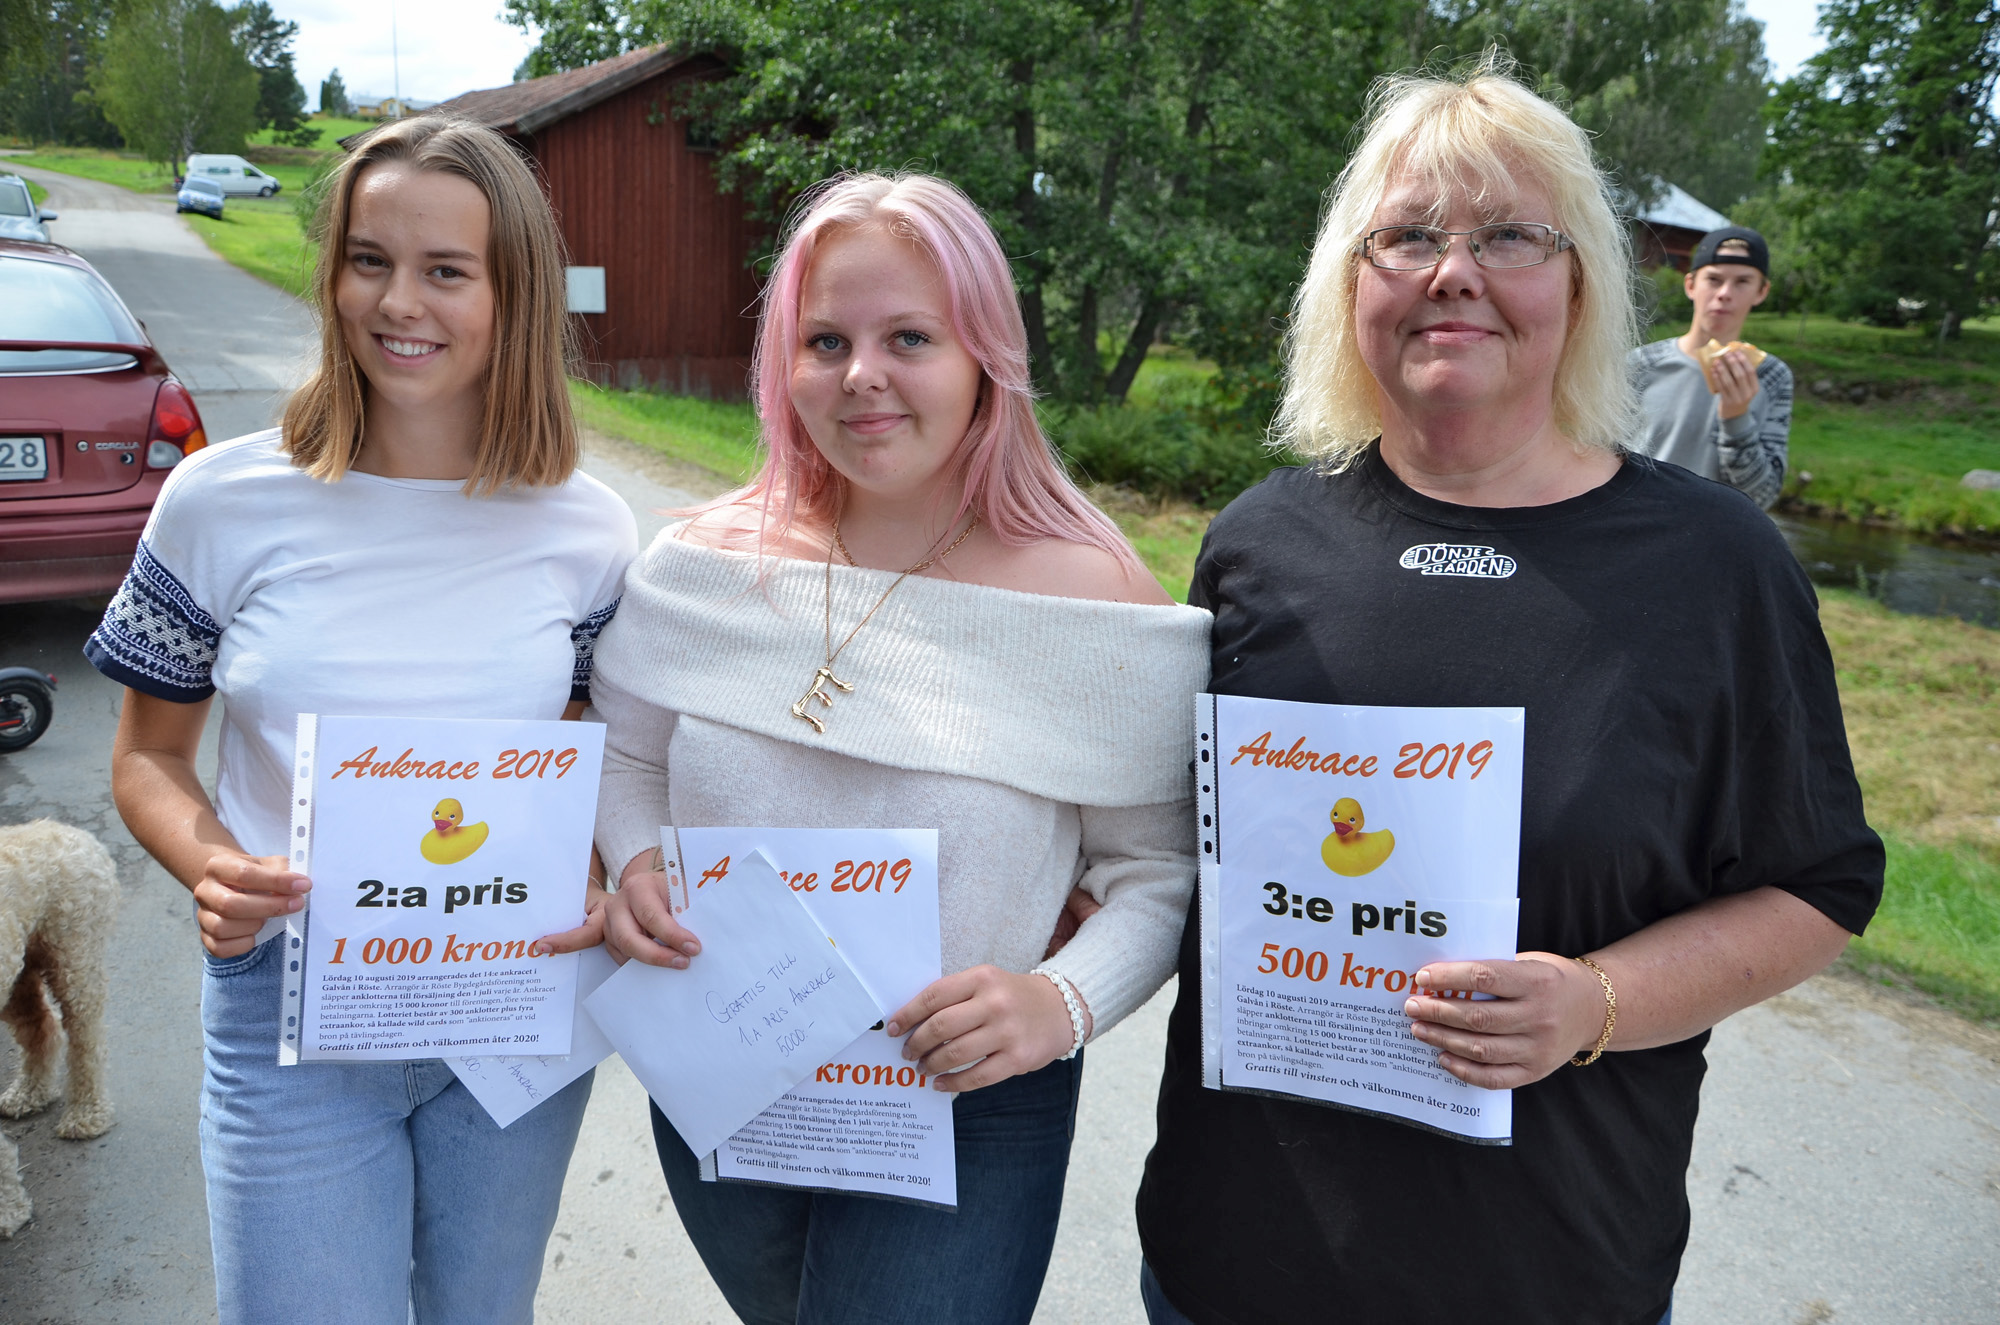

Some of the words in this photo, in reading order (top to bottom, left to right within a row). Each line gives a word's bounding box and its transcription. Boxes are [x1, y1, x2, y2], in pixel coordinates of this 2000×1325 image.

[1413, 543, 1482, 566] DÖNJE
[331, 745, 479, 780] Ankrace
[491, 747, 579, 780] 2019
[1230, 731, 1378, 777] Ankrace
[1393, 739, 1494, 780] 2019
[830, 858, 912, 893] 2019
[355, 879, 428, 908] 2:a
[444, 876, 529, 914] pris
[1262, 881, 1334, 923] 3:e
[1351, 900, 1448, 938] pris
[328, 937, 348, 964] 1
[362, 936, 433, 965] 000
[441, 933, 555, 964] krono
[1257, 942, 1329, 982] 500
[322, 974, 352, 982] Lördag
[364, 974, 395, 982] augusti
[416, 972, 468, 981] arrangerades
[499, 968, 531, 976] ankracet
[766, 953, 797, 981] TILL
[321, 983, 351, 991] Galvån
[383, 983, 420, 992] Arrangör
[453, 978, 525, 989] Bygdegårdsförening
[321, 993, 349, 1002] släpper
[412, 991, 456, 999] försäljning
[478, 988, 492, 997] juli
[493, 987, 512, 995] varje
[523, 985, 556, 993] Ankracet
[320, 1003, 358, 1011] inbringar
[358, 1002, 393, 1010] omkring
[464, 1006, 500, 1014] anklotter
[500, 1005, 517, 1013] plus
[518, 1004, 534, 1012] fyra
[1236, 983, 1264, 998] Lördag
[1266, 989, 1276, 997] 10
[1276, 993, 1307, 1002] augusti
[1308, 996, 1329, 1006] 2019
[1330, 1001, 1386, 1014] arrangerades
[1387, 1007, 1402, 1017] det
[1236, 994, 1264, 1006] Galvån
[1296, 1006, 1334, 1018] Arrangör
[1335, 1011, 1344, 1019] är
[1345, 1012, 1369, 1023] Röste
[376, 1019, 406, 1027] kallade
[524, 1012, 536, 1020] vid
[1236, 1006, 1263, 1018] släpper
[1264, 1011, 1312, 1025] anklotterna
[1313, 1019, 1326, 1027] till
[1327, 1020, 1375, 1035] försäljning
[1375, 1027, 1392, 1036] den
[1236, 1016, 1272, 1030] inbringar
[1273, 1024, 1308, 1036] omkring
[1309, 1028, 1320, 1036] 15
[1320, 1030, 1337, 1039] 000
[1337, 1032, 1368, 1043] kronor
[1369, 1037, 1381, 1045] till
[318, 1042, 355, 1051] Grattis
[356, 1041, 372, 1050] till
[373, 1041, 410, 1049] vinsten
[411, 1038, 430, 1047] och
[432, 1037, 490, 1046] välkommen
[491, 1034, 511, 1043] åter
[513, 1034, 539, 1042] 2020!
[1284, 1044, 1294, 1052] så
[1294, 1045, 1324, 1058] kallade
[1325, 1052, 1344, 1061] wild
[1345, 1056, 1369, 1064] cards
[1370, 1060, 1387, 1068] som
[1293, 1035, 1329, 1048] Lotteriet
[1330, 1041, 1357, 1052] består
[1370, 1048, 1386, 1057] 300
[1386, 1052, 1426, 1065] anklotter
[798, 1096, 844, 1105] arrangerades
[874, 1099, 906, 1108] ankracet
[1244, 1062, 1281, 1073] Grattis
[1283, 1067, 1298, 1077] till
[1300, 1071, 1337, 1084] vinsten
[1339, 1078, 1359, 1088] och
[1361, 1082, 1424, 1102] välkommen
[1426, 1095, 1448, 1109] åter
[1449, 1102, 1480, 1117] 2020!
[786, 1111, 798, 1120] till
[798, 1114, 837, 1125] försäljning
[837, 1116, 852, 1125] den
[858, 1118, 872, 1127] juli
[872, 1120, 890, 1128] varje
[901, 1121, 933, 1130] Ankracet
[772, 1130, 802, 1140] Lotteriet
[802, 1133, 824, 1142] består
[835, 1136, 848, 1144] 300
[849, 1137, 883, 1146] anklotter
[883, 1139, 900, 1148] plus
[900, 1140, 916, 1150] fyra
[736, 1155, 765, 1166] Grattis
[767, 1160, 779, 1169] till
[780, 1162, 812, 1172] vinsten
[813, 1165, 830, 1174] och
[831, 1167, 885, 1179] välkommen
[887, 1171, 905, 1181] åter
[906, 1174, 931, 1186] 2020!
